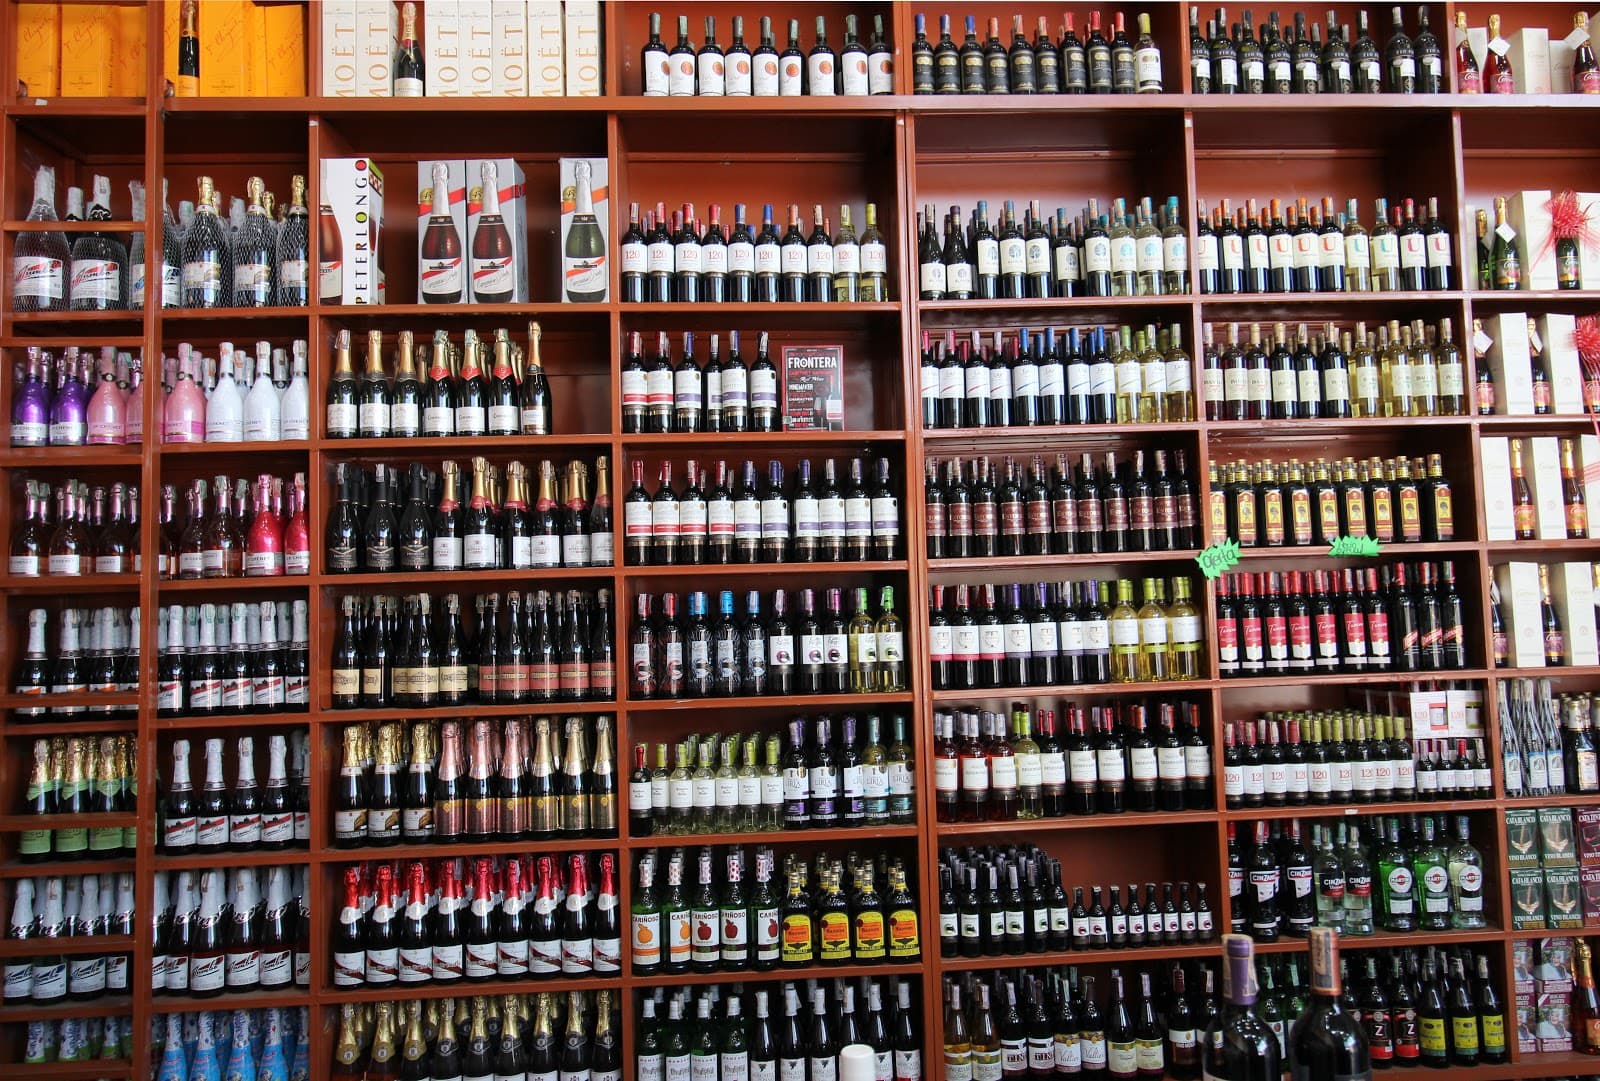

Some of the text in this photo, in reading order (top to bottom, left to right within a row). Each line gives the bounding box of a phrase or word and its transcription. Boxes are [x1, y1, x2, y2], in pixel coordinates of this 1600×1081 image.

[355, 159, 368, 305] PETERLONGO
[1276, 238, 1290, 252] U
[1297, 237, 1311, 252] U
[1322, 237, 1336, 251] U
[1407, 238, 1421, 252] U
[1435, 238, 1448, 251] U
[736, 249, 750, 258] 120
[817, 251, 831, 260] 120
[788, 357, 837, 368] FRONTERA
[1202, 549, 1236, 569] Oferta
[1311, 771, 1328, 780] 120
[1375, 769, 1390, 778] 120
[1397, 768, 1412, 777] 120
[1225, 774, 1241, 783] 120
[1375, 1025, 1383, 1036] Z
[1407, 1023, 1415, 1035] Z
